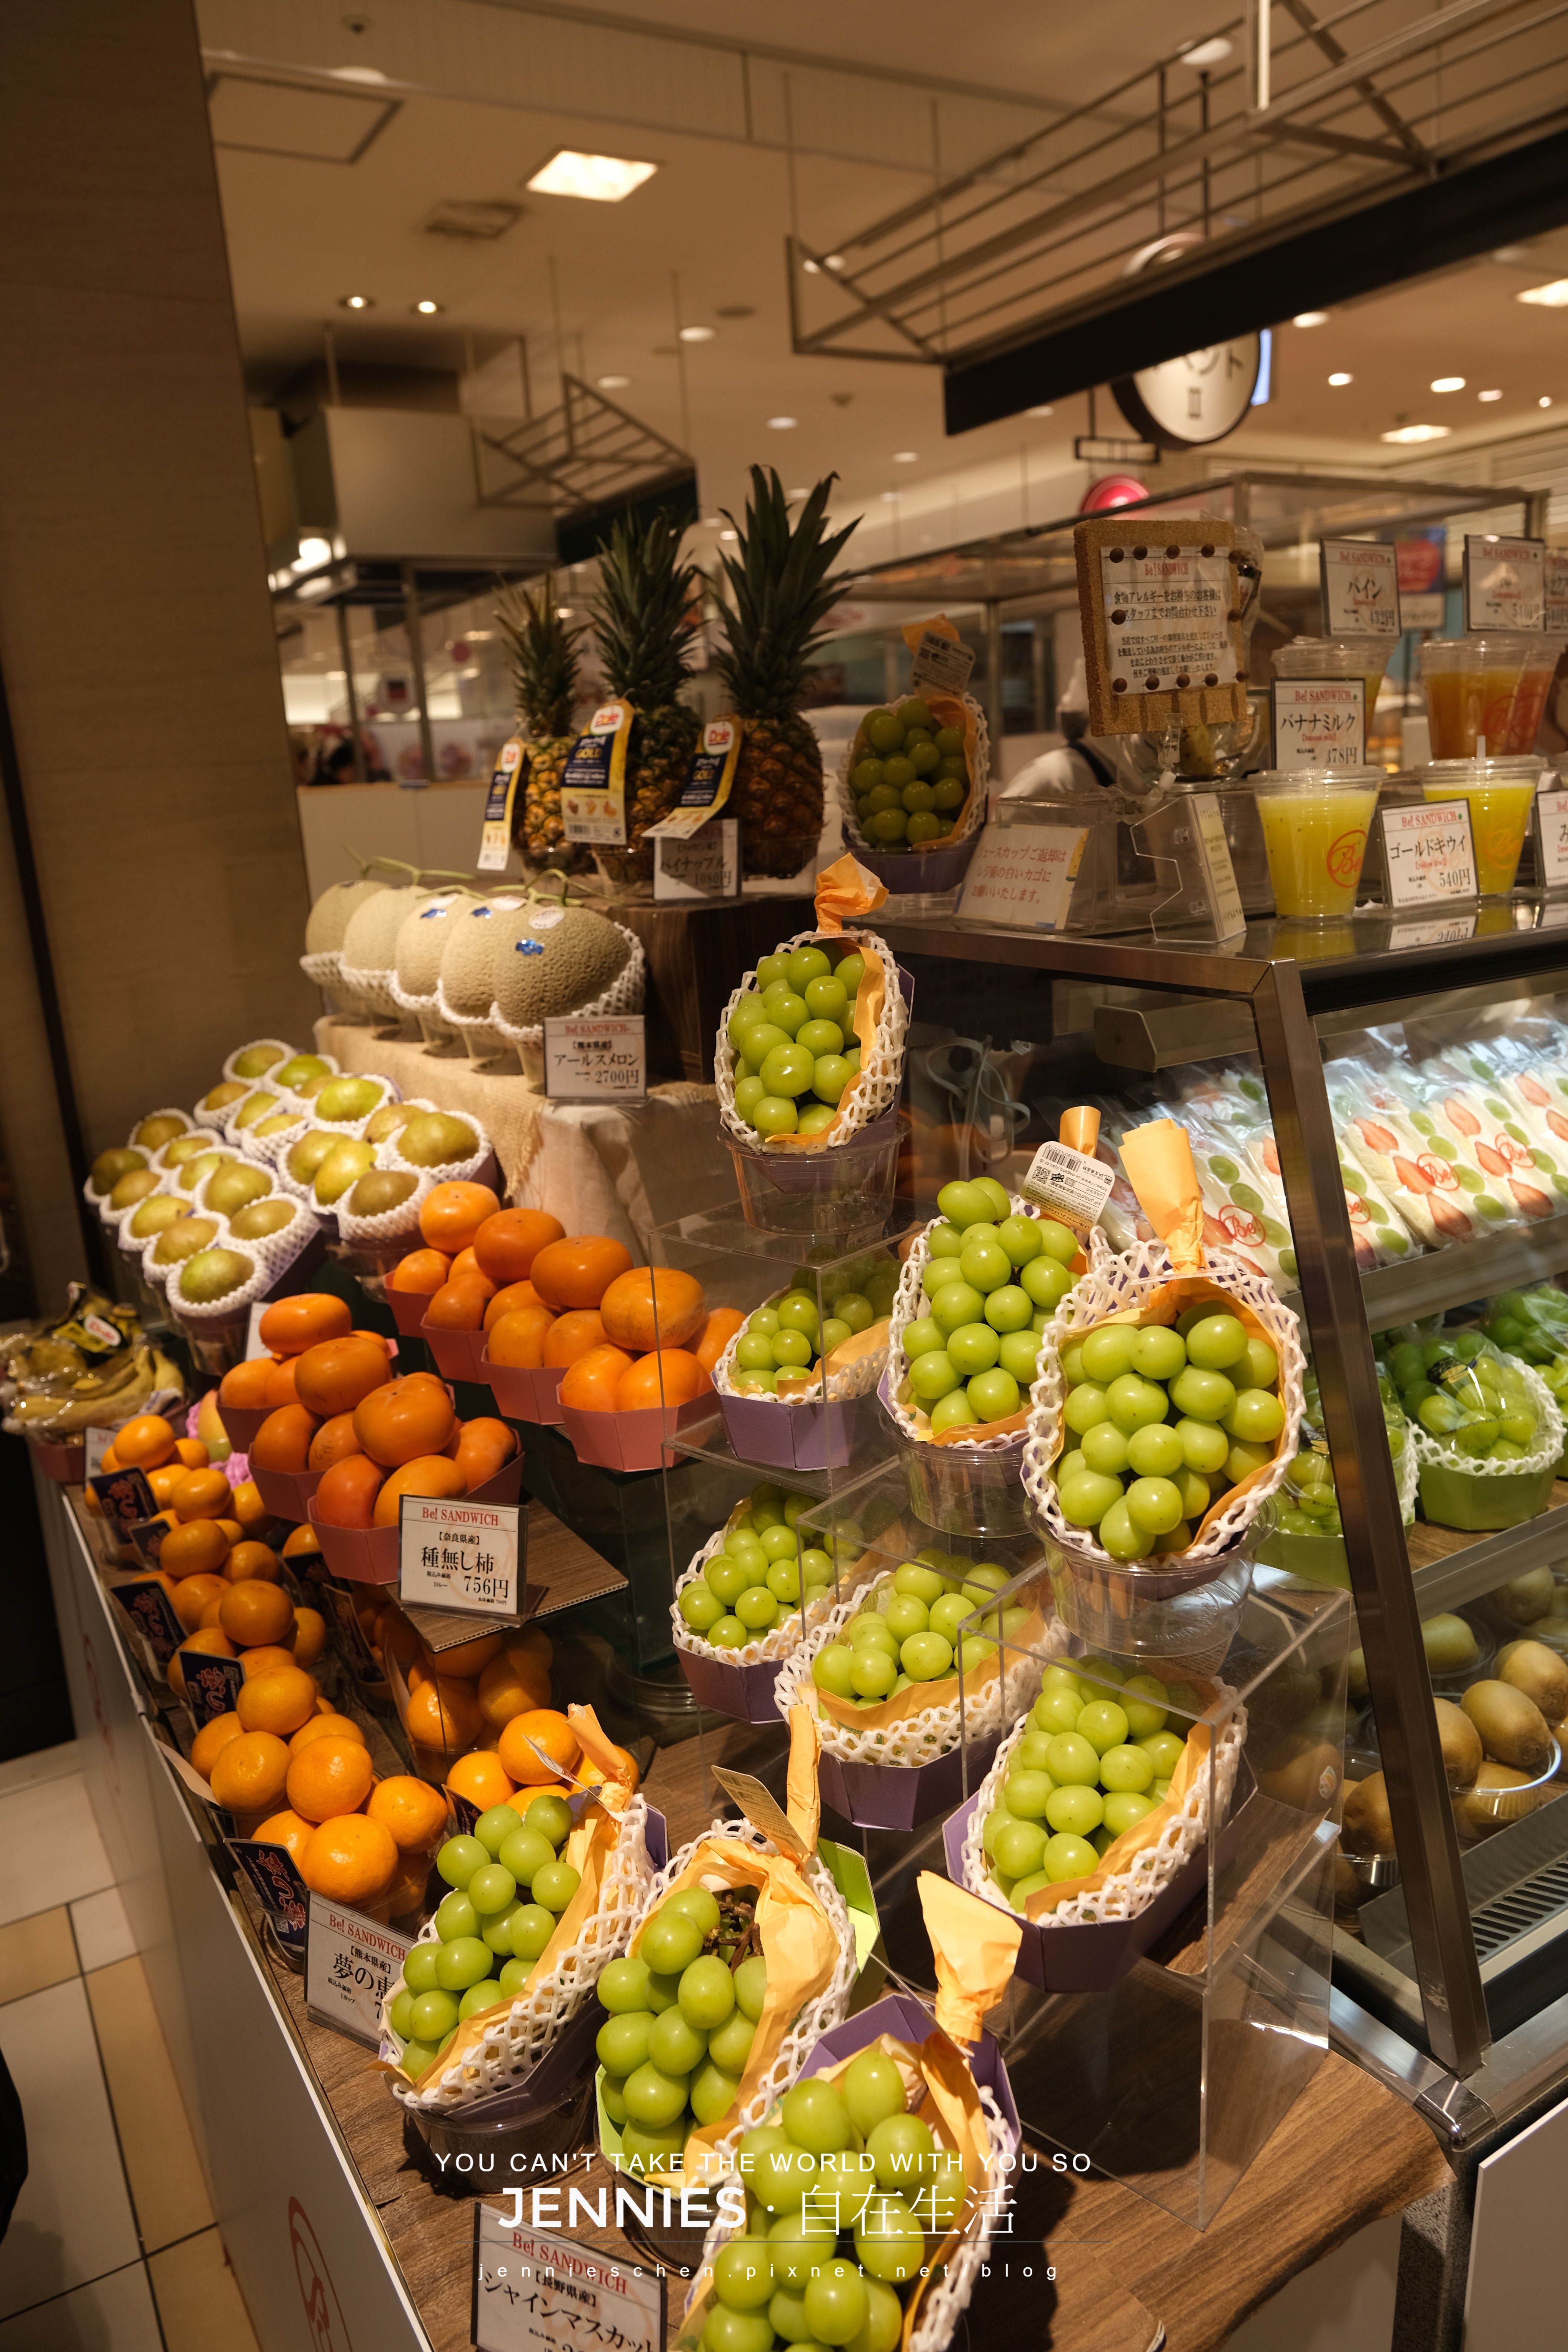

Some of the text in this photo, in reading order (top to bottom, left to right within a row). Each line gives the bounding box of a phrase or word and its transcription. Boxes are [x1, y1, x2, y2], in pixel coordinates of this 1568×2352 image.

[1347, 576, 1383, 600] パイン
[1309, 690, 1351, 701] SANDWICH
[1280, 713, 1355, 732] バナナミルク
[1416, 811, 1456, 826] SANDWICH
[1390, 835, 1465, 859] ゴールドキウイ
[1440, 868, 1470, 888] 540円
[972, 884, 1040, 903] お願いいたします。
[580, 1023, 627, 1033] SANDWICH
[554, 1053, 639, 1066] アールスメロン
[595, 1069, 639, 1084] 2700円
[422, 1507, 498, 1526] Be! SANDWICH
[439, 1531, 479, 1545] 【奈良県産】
[421, 1546, 494, 1574] 種無し柿
[464, 1576, 508, 1599] 756円
[329, 1914, 406, 1961] Be! SANDWICH
[351, 1946, 391, 1974] 【熊本県産】
[328, 1977, 352, 1994] 税込み価格
[512, 2232, 627, 2295] Be! SANDWICH
[536, 2270, 597, 2308] 【長野県産】
[485, 2271, 654, 2352] シャインマスカット
